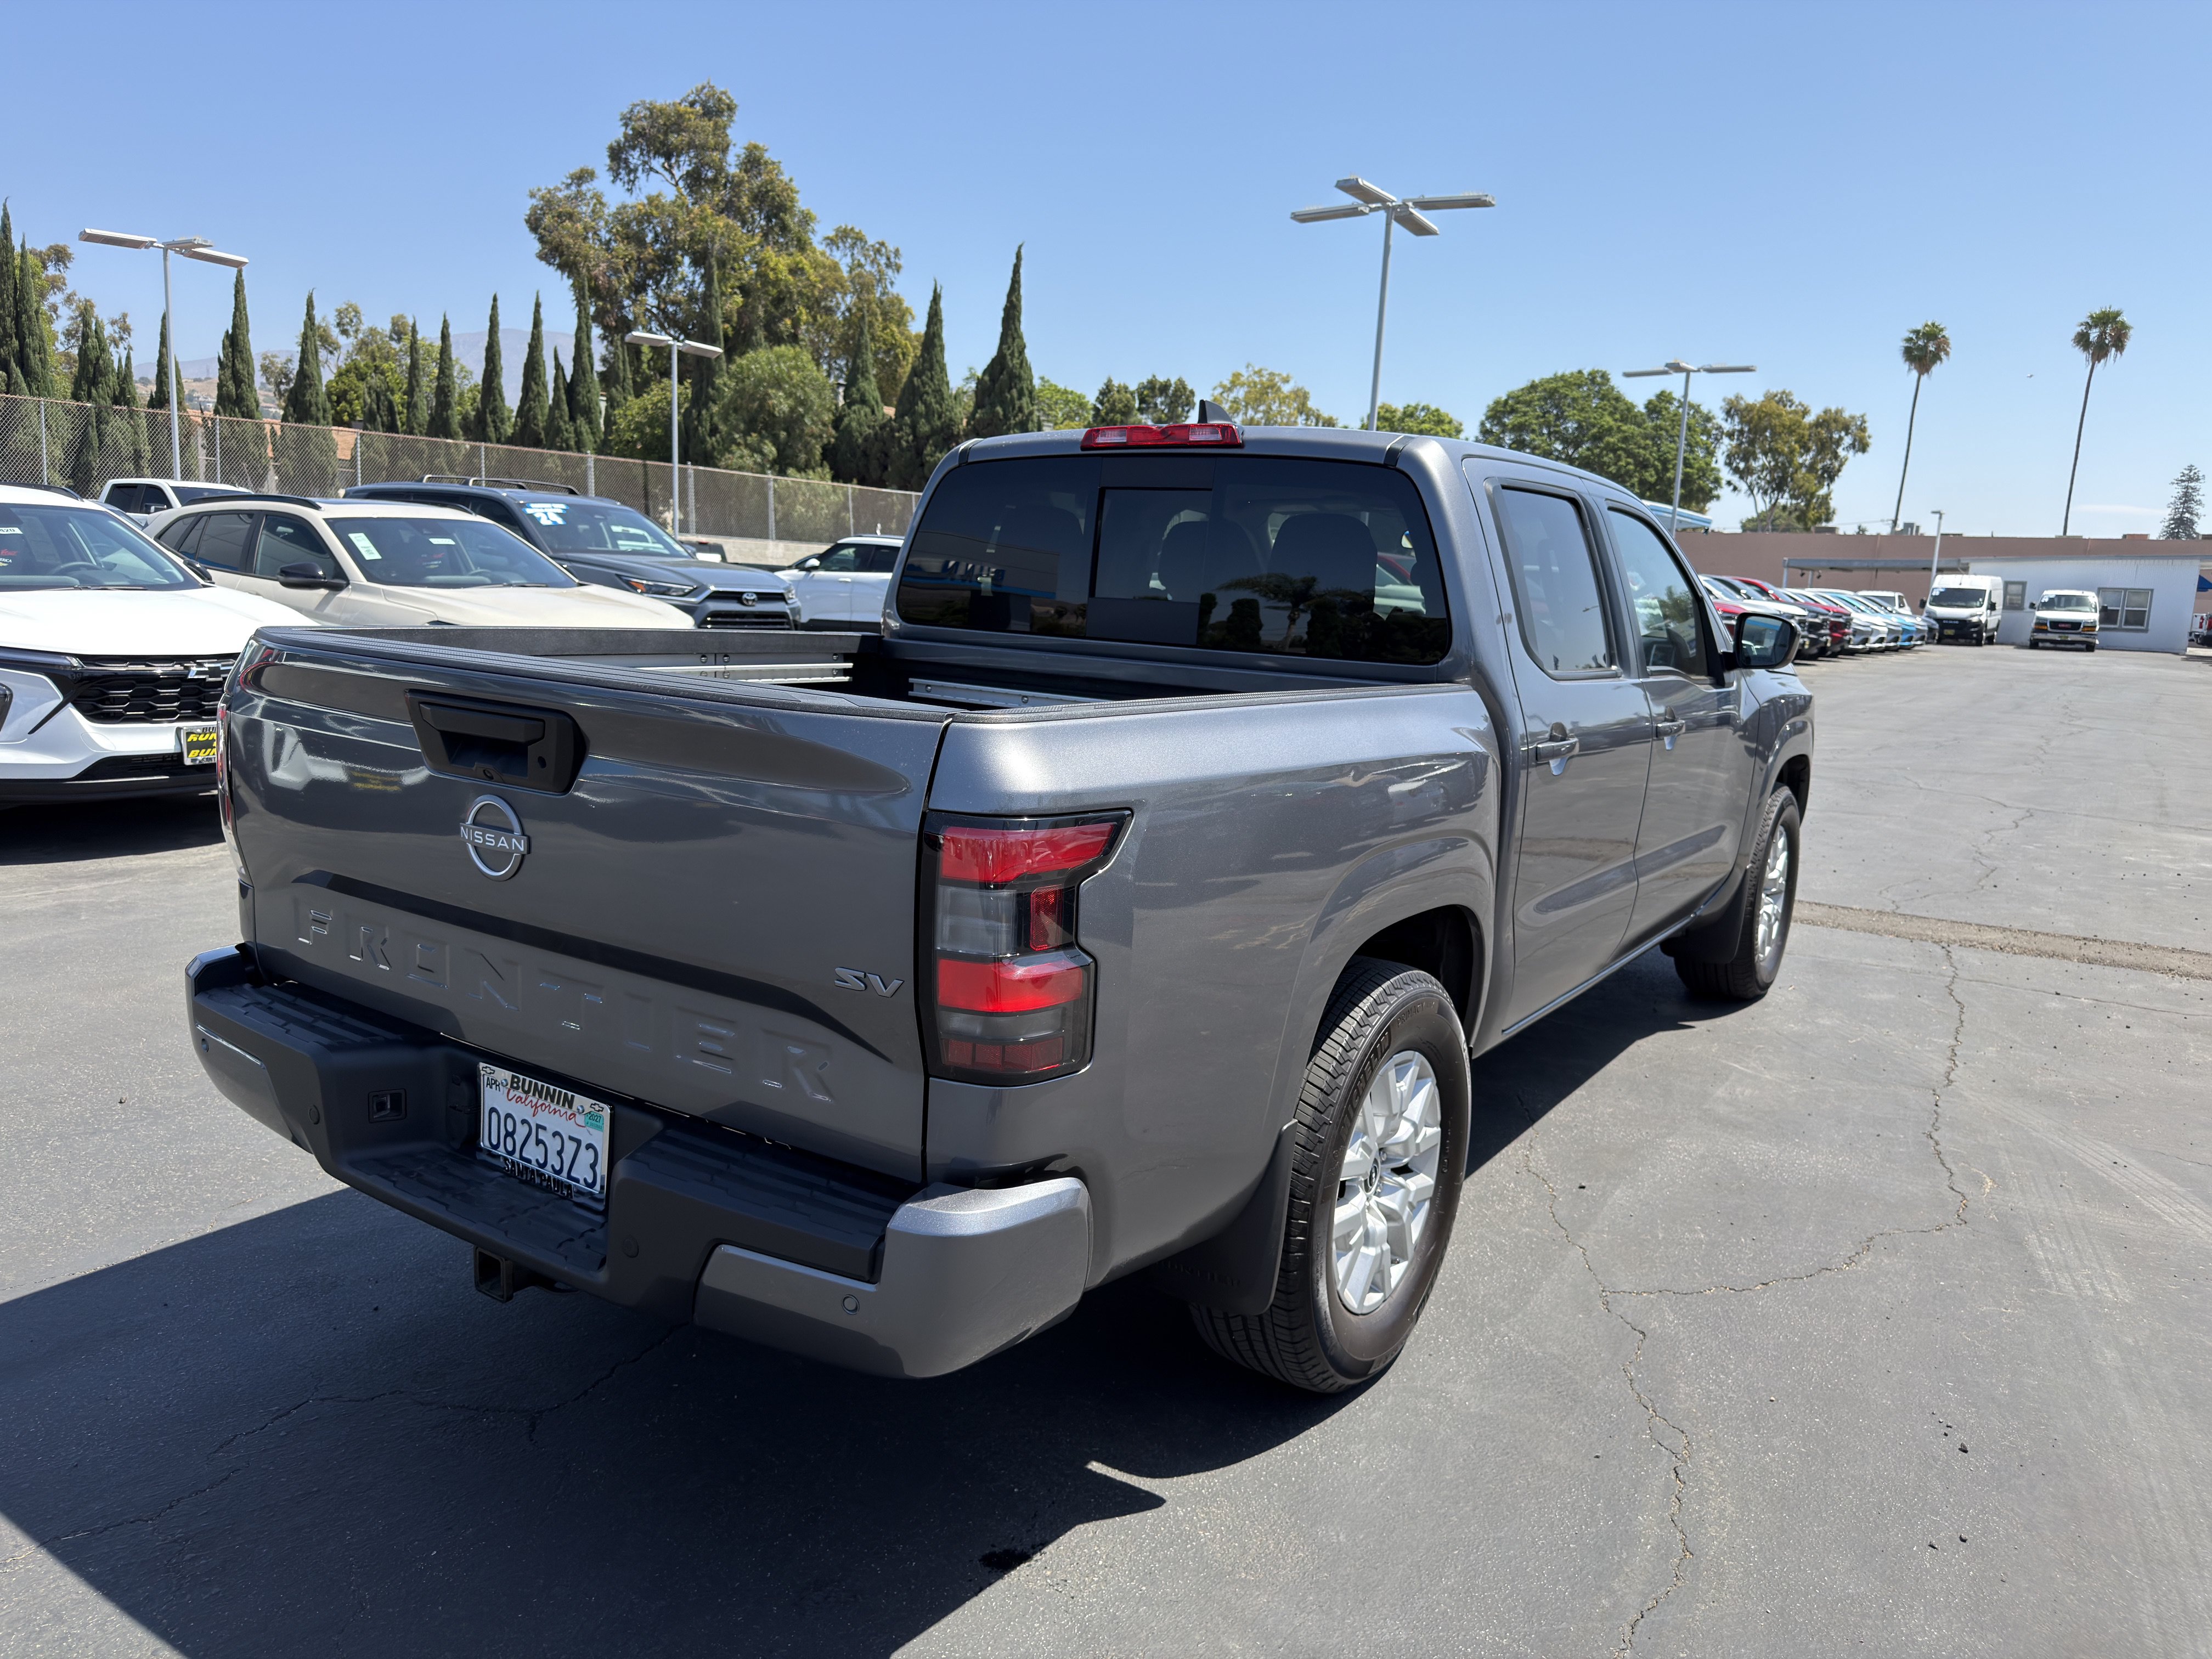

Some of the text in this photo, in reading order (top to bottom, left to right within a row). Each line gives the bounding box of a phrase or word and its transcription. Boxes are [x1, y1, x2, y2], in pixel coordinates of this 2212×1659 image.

[461, 826, 524, 851] NISSAN
[293, 894, 833, 1103] FRONTIER
[834, 967, 905, 998] SV
[486, 1076, 500, 1092] APR
[510, 1074, 575, 1109] BUNNIN
[1340, 1031, 1390, 1143] MICHELIN
[506, 1088, 585, 1128] California
[589, 1113, 602, 1124] 2027
[504, 1157, 574, 1199] SANTA PAULA
